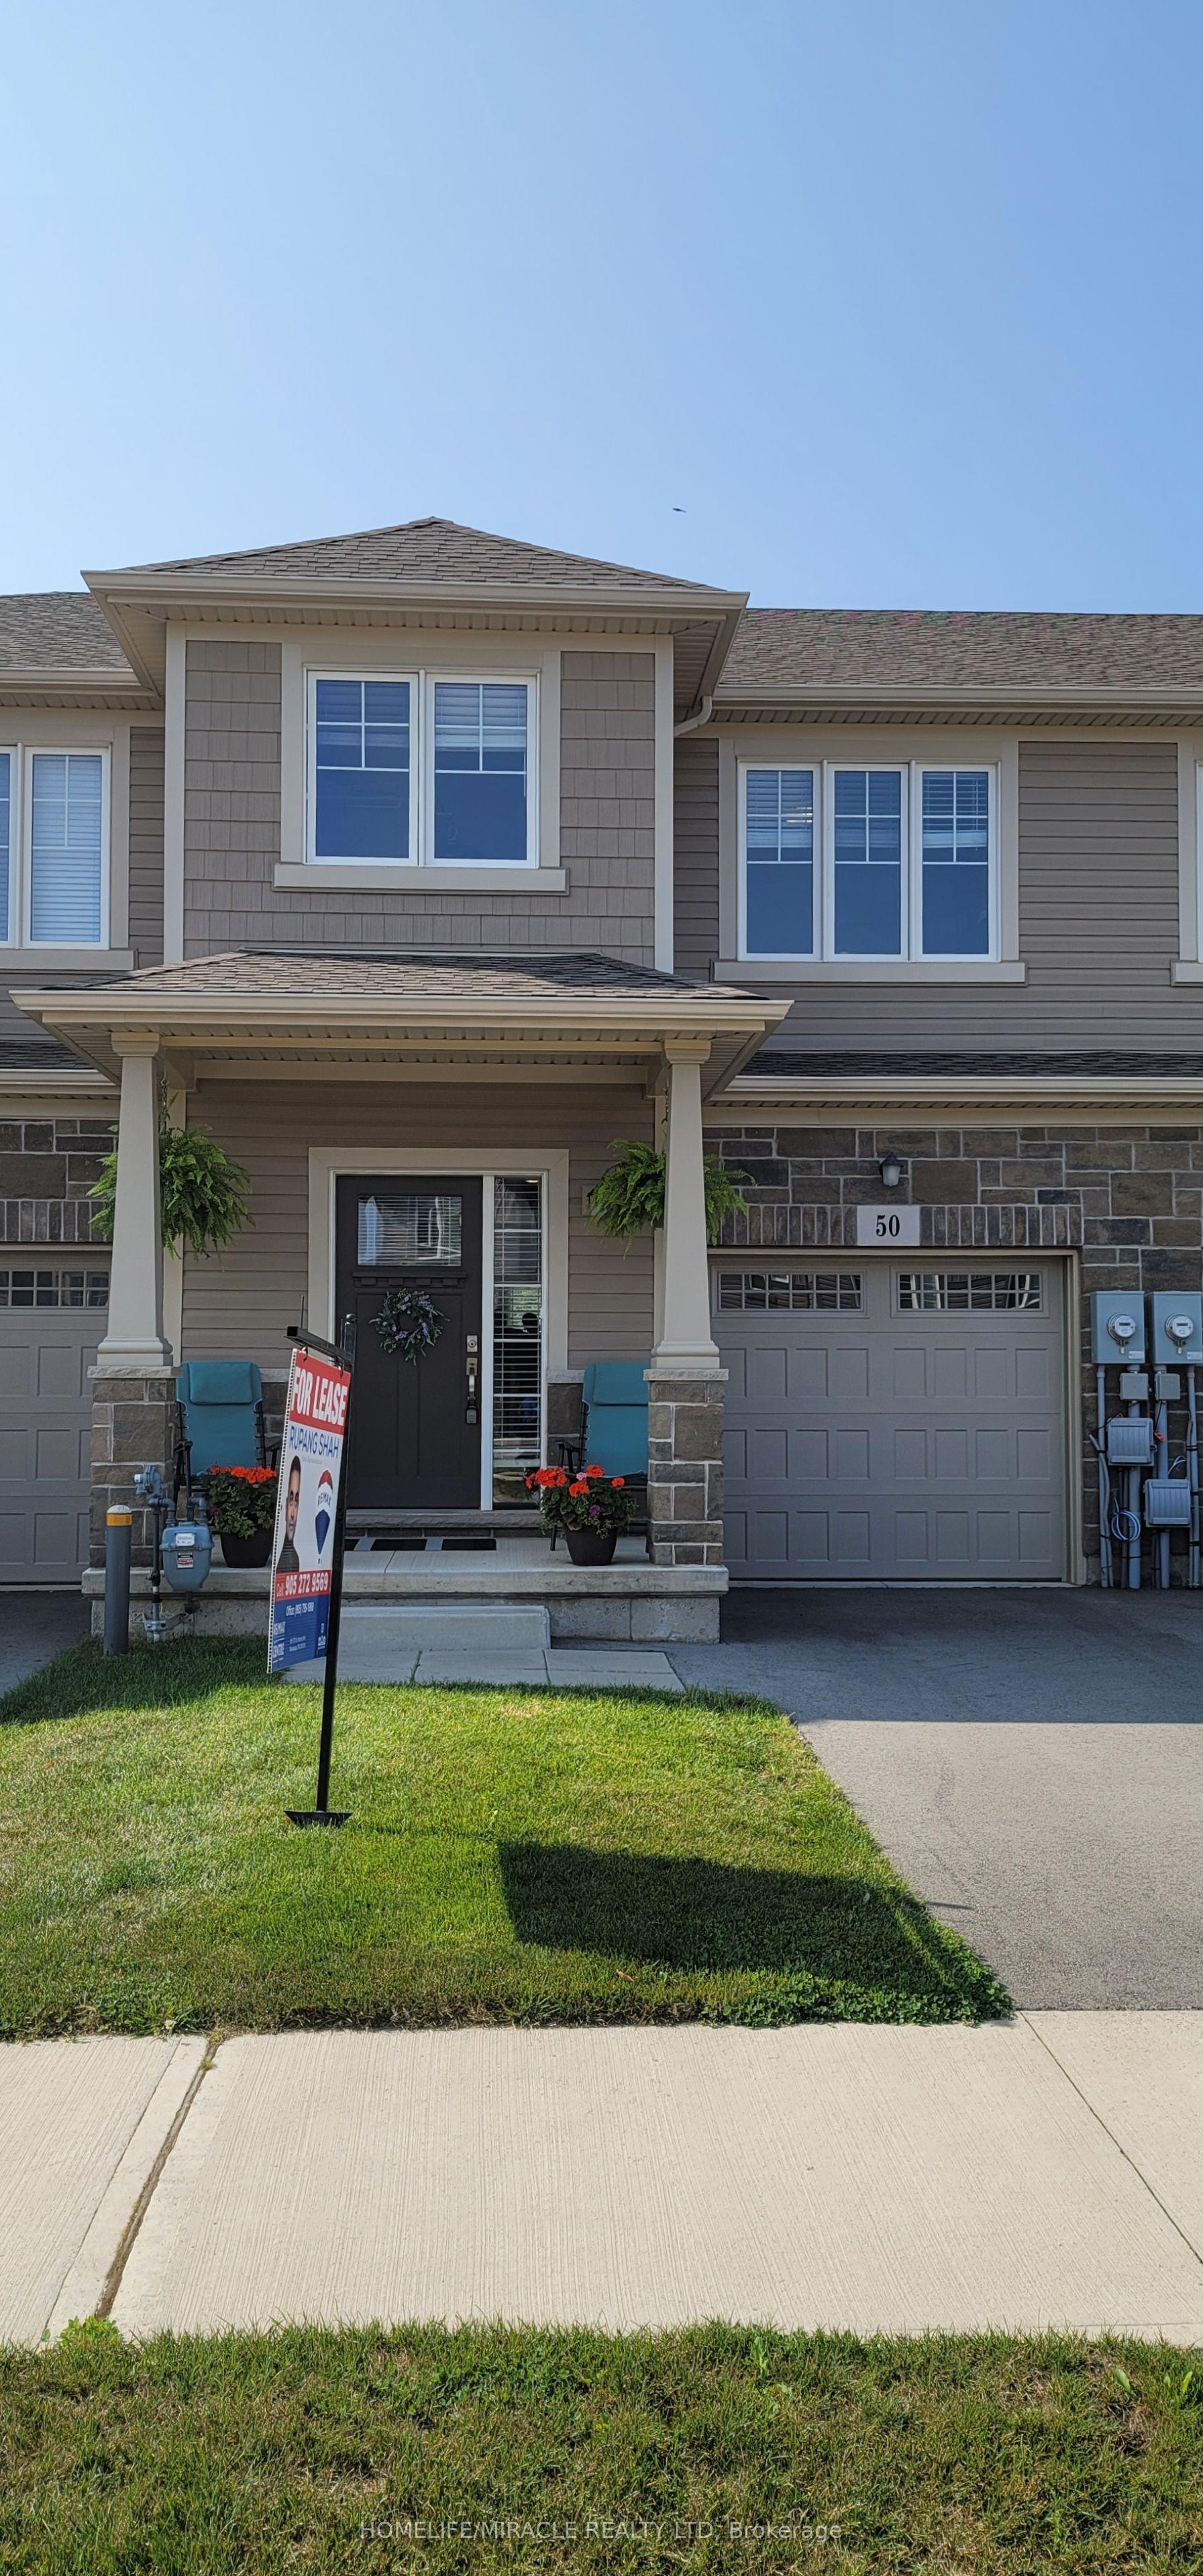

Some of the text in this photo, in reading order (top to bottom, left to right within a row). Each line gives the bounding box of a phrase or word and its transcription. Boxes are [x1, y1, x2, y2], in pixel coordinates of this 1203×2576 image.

[876, 1214, 900, 1237] 50
[291, 1366, 348, 1427] FOR LEASE
[289, 1426, 340, 1459] RUPANG SHAH
[317, 1492, 332, 1507] RE/MAX
[285, 1575, 297, 1595] 905
[298, 1573, 311, 1594] 272
[312, 1572, 329, 1592] 9569
